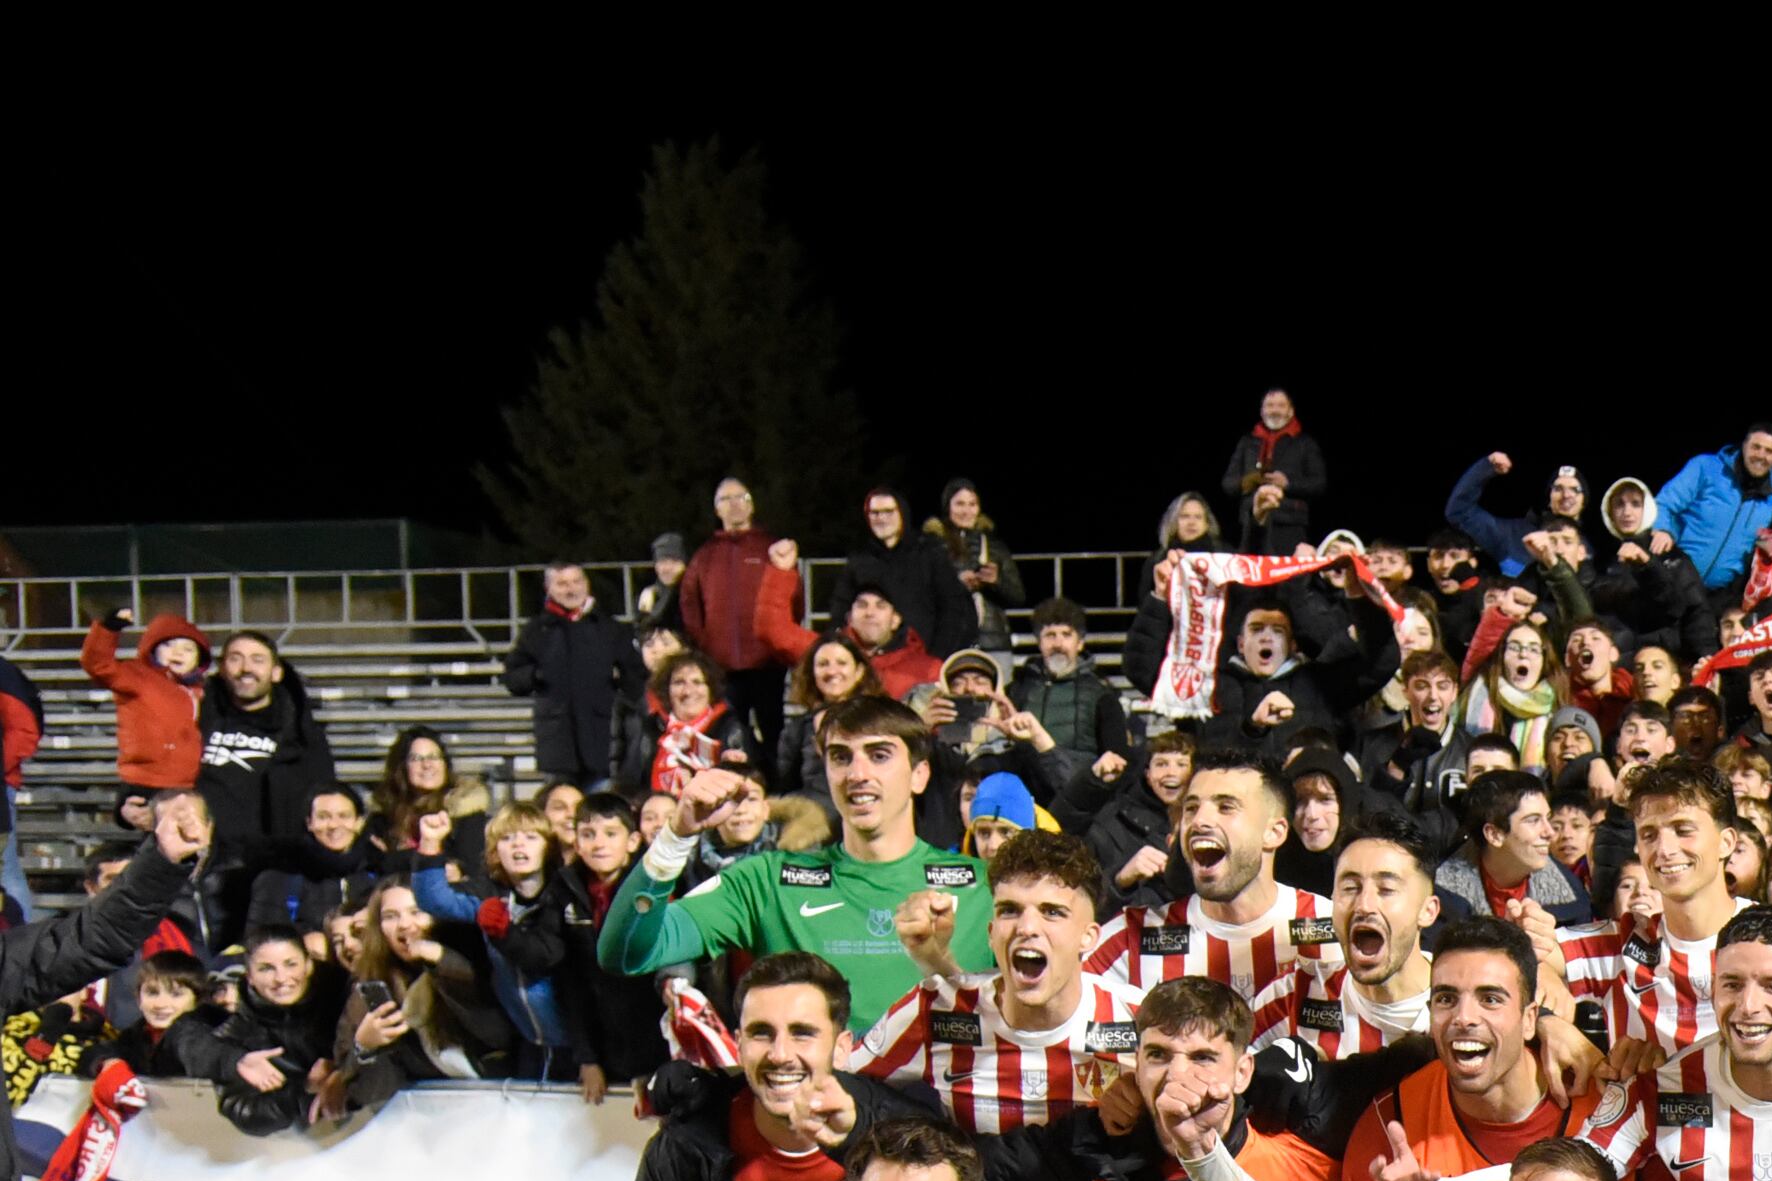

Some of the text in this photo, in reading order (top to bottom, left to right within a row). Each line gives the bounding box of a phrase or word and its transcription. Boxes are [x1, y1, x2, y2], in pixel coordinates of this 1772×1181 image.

[1142, 931, 1188, 945] Huesca
[932, 1020, 980, 1035] Huesca
[1086, 1029, 1138, 1043] Huesca
[1659, 1102, 1711, 1117] Huesca
